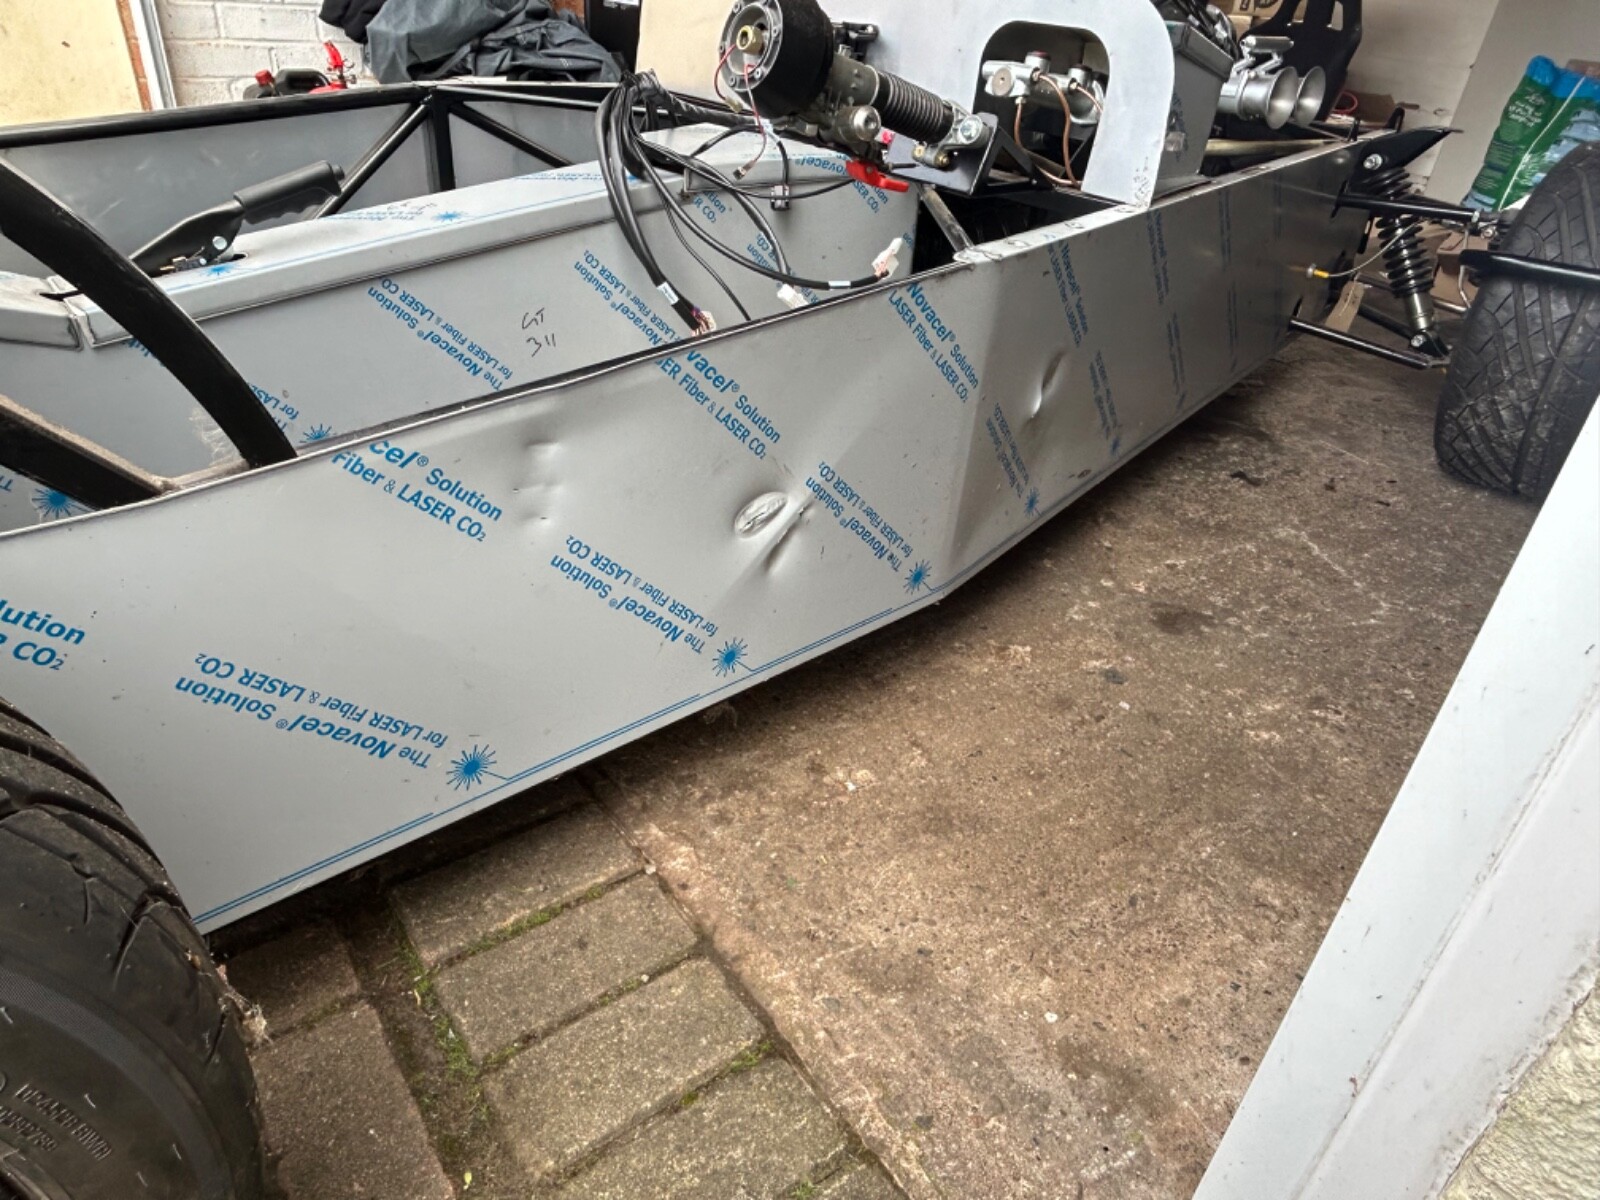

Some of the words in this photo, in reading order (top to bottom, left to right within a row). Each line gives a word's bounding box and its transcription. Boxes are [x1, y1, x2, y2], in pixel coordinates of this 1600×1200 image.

[574, 261, 614, 301] Solution
[598, 265, 626, 294] LASER
[367, 286, 419, 330] Solution
[399, 290, 435, 321] LASER
[630, 295, 652, 317] Fiber
[441, 322, 468, 346] Fiber
[650, 313, 676, 340] LASER
[888, 289, 916, 329] LASER
[912, 322, 934, 352] Fiber
[934, 353, 960, 388] LASER
[467, 341, 499, 369] LASER
[950, 343, 979, 389] Solution
[483, 371, 503, 391] The
[499, 365, 513, 380] for
[279, 402, 299, 420] for
[679, 373, 710, 405] Fiber
[714, 406, 751, 444] LASER
[734, 394, 781, 444] Solution
[384, 479, 396, 494] &
[396, 483, 456, 525] LASER
[425, 467, 503, 521] Solution
[805, 476, 845, 518] Solution
[833, 476, 862, 507] LASER
[863, 504, 884, 529] Fiber
[880, 521, 904, 549] LASER
[550, 554, 613, 600] Solution
[590, 551, 633, 585] LASER
[639, 581, 671, 607] Fiber
[668, 599, 704, 630] LASER
[702, 620, 719, 638] for
[683, 632, 706, 655] The
[175, 677, 277, 720] Solution
[238, 667, 307, 702] LASER
[309, 690, 320, 704] &
[319, 696, 368, 722] Fiber
[368, 711, 424, 740] LASER
[422, 730, 448, 748] for
[398, 746, 431, 769] The
